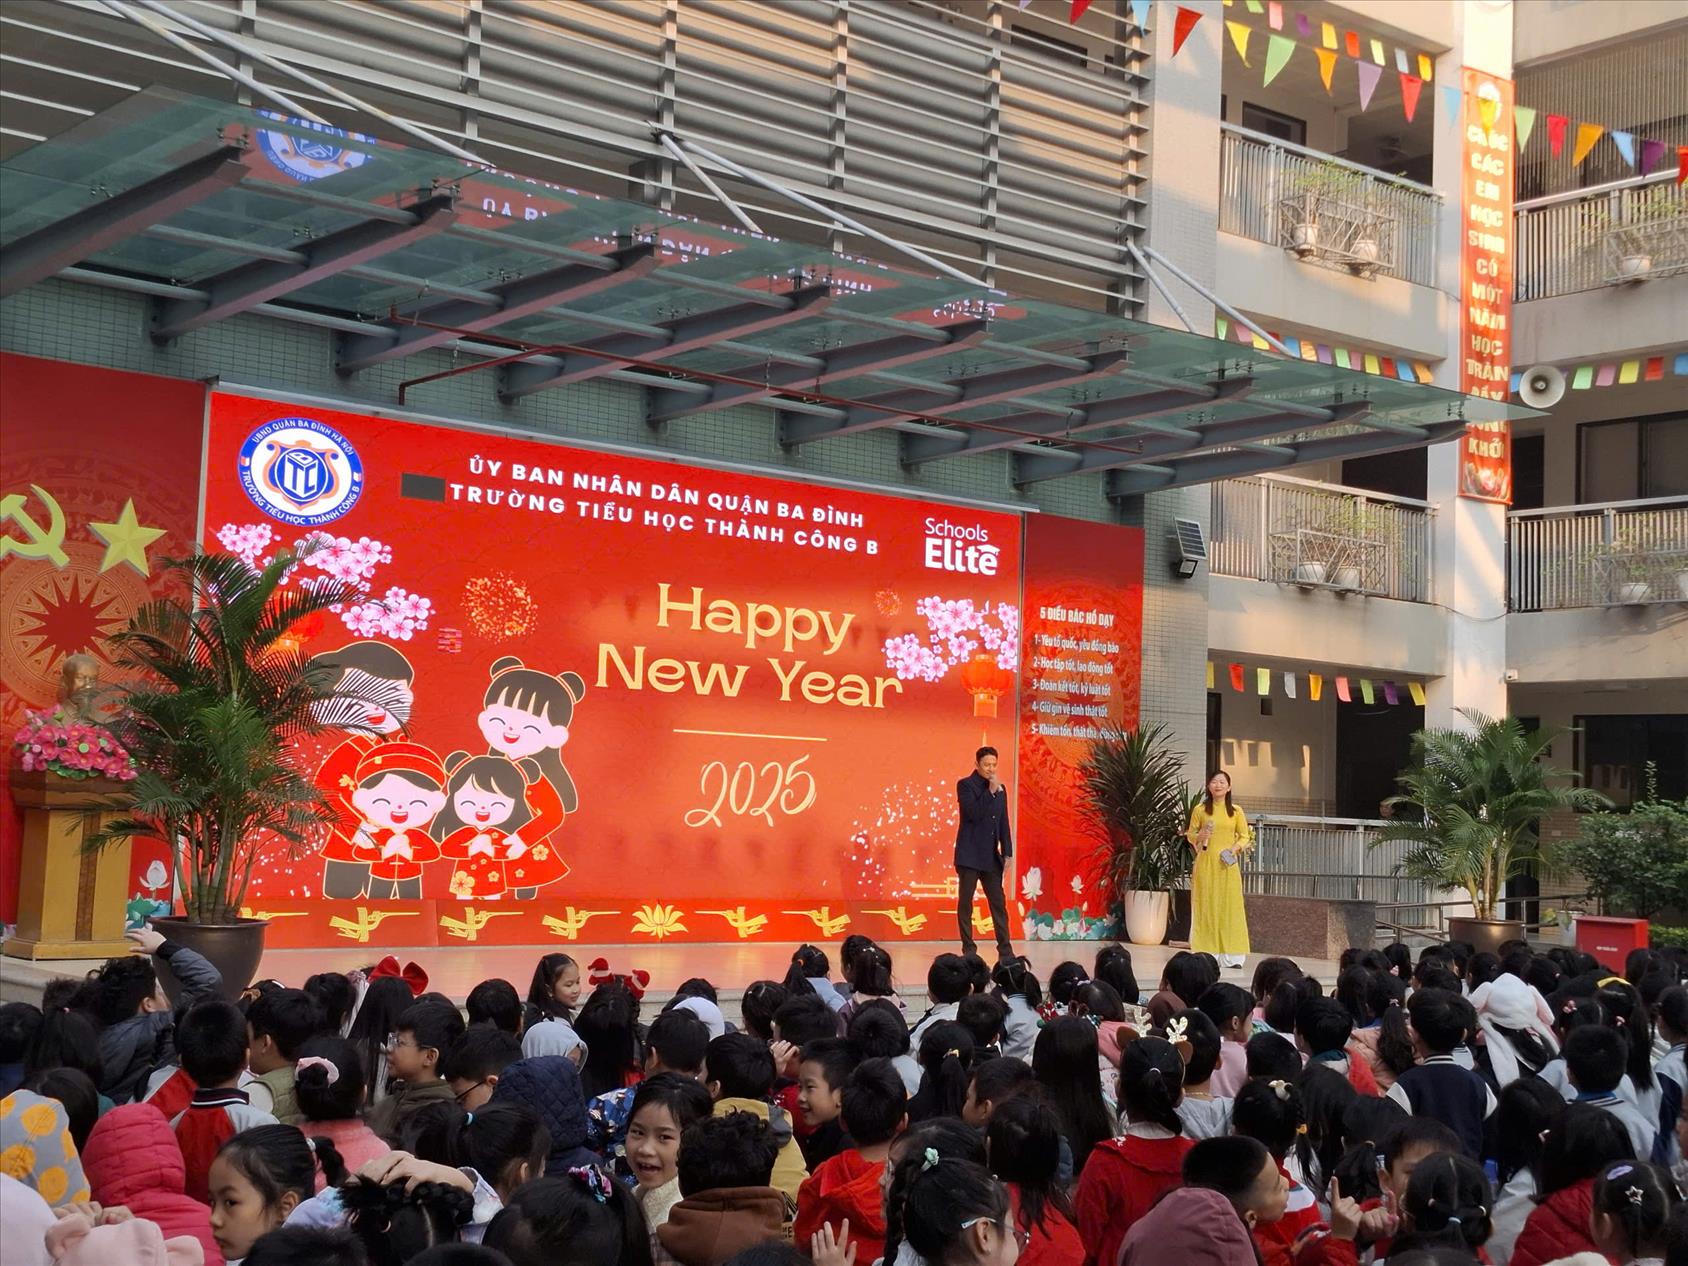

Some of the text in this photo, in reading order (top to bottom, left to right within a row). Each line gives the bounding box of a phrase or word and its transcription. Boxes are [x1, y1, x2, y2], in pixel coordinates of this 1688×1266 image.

[1471, 152, 1504, 176] CÁC
[1475, 179, 1500, 201] EM
[1470, 204, 1503, 227] HỌC
[1469, 230, 1505, 254] SINH
[1476, 257, 1498, 277] CÓ
[1471, 282, 1503, 305] MỘT
[1469, 306, 1506, 330] NĂM
[1471, 334, 1503, 356] HỌC
[1466, 358, 1508, 381] TRÀN
[252, 426, 272, 443] UBND
[298, 420, 309, 428] BA
[469, 454, 864, 528] ỦY BAN NHÂN DÂN QUẬN BA ĐÌNH
[286, 514, 306, 526] HỌC
[449, 483, 878, 554] TRƯỜNG TIỂU HỌC THÀNH CÔNG B
[925, 517, 989, 542] Schools
[925, 537, 1000, 576] Elite
[656, 582, 856, 655] Happy
[1040, 606, 1046, 620] 5
[594, 643, 904, 709] New Year
[684, 754, 817, 828] 2025
